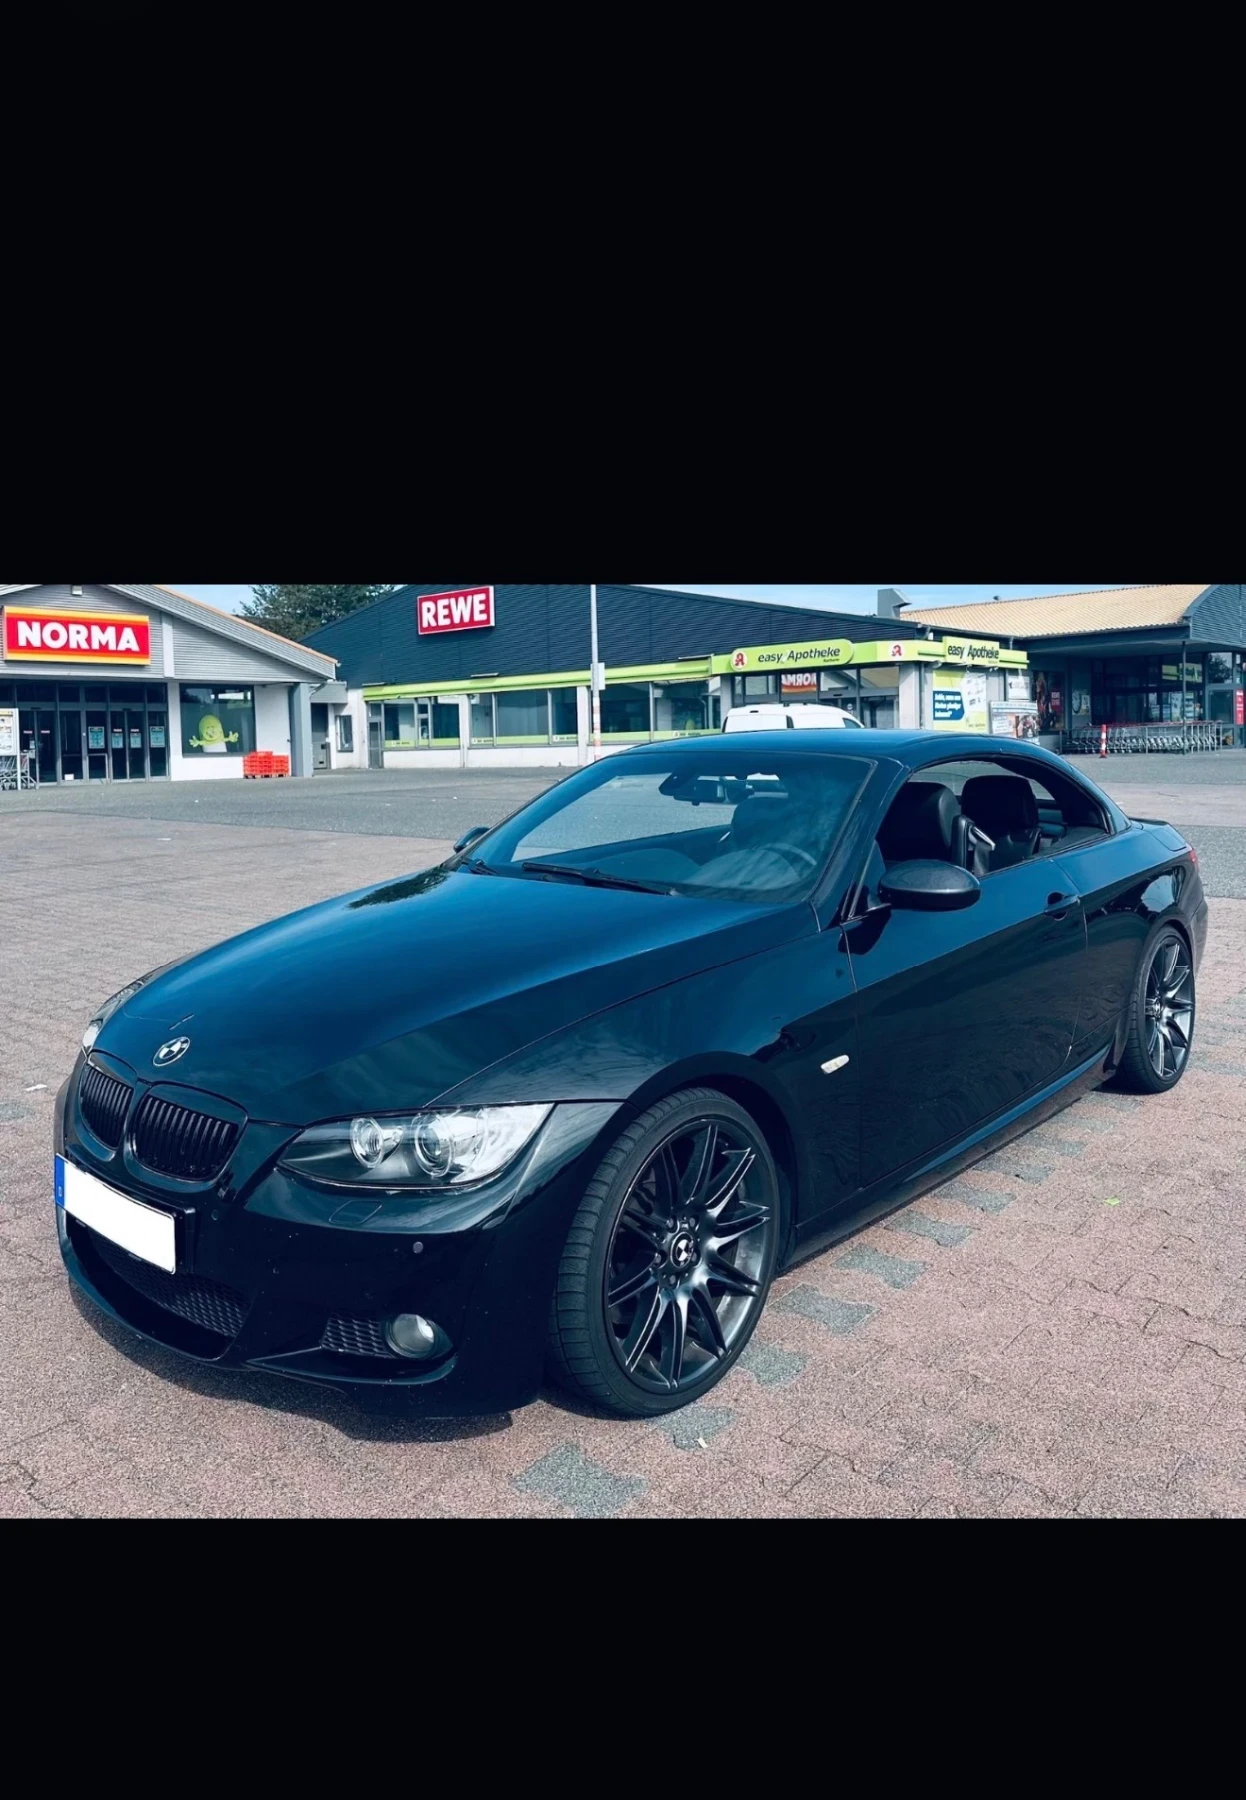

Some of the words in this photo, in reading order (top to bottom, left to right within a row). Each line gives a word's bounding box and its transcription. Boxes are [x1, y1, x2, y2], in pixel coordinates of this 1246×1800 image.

[421, 593, 488, 628] REWE
[17, 620, 141, 653] NORMA
[757, 653, 783, 664] easy
[786, 647, 841, 663] Apotheke
[947, 645, 965, 659] easy
[967, 644, 1000, 661] Apotheke
